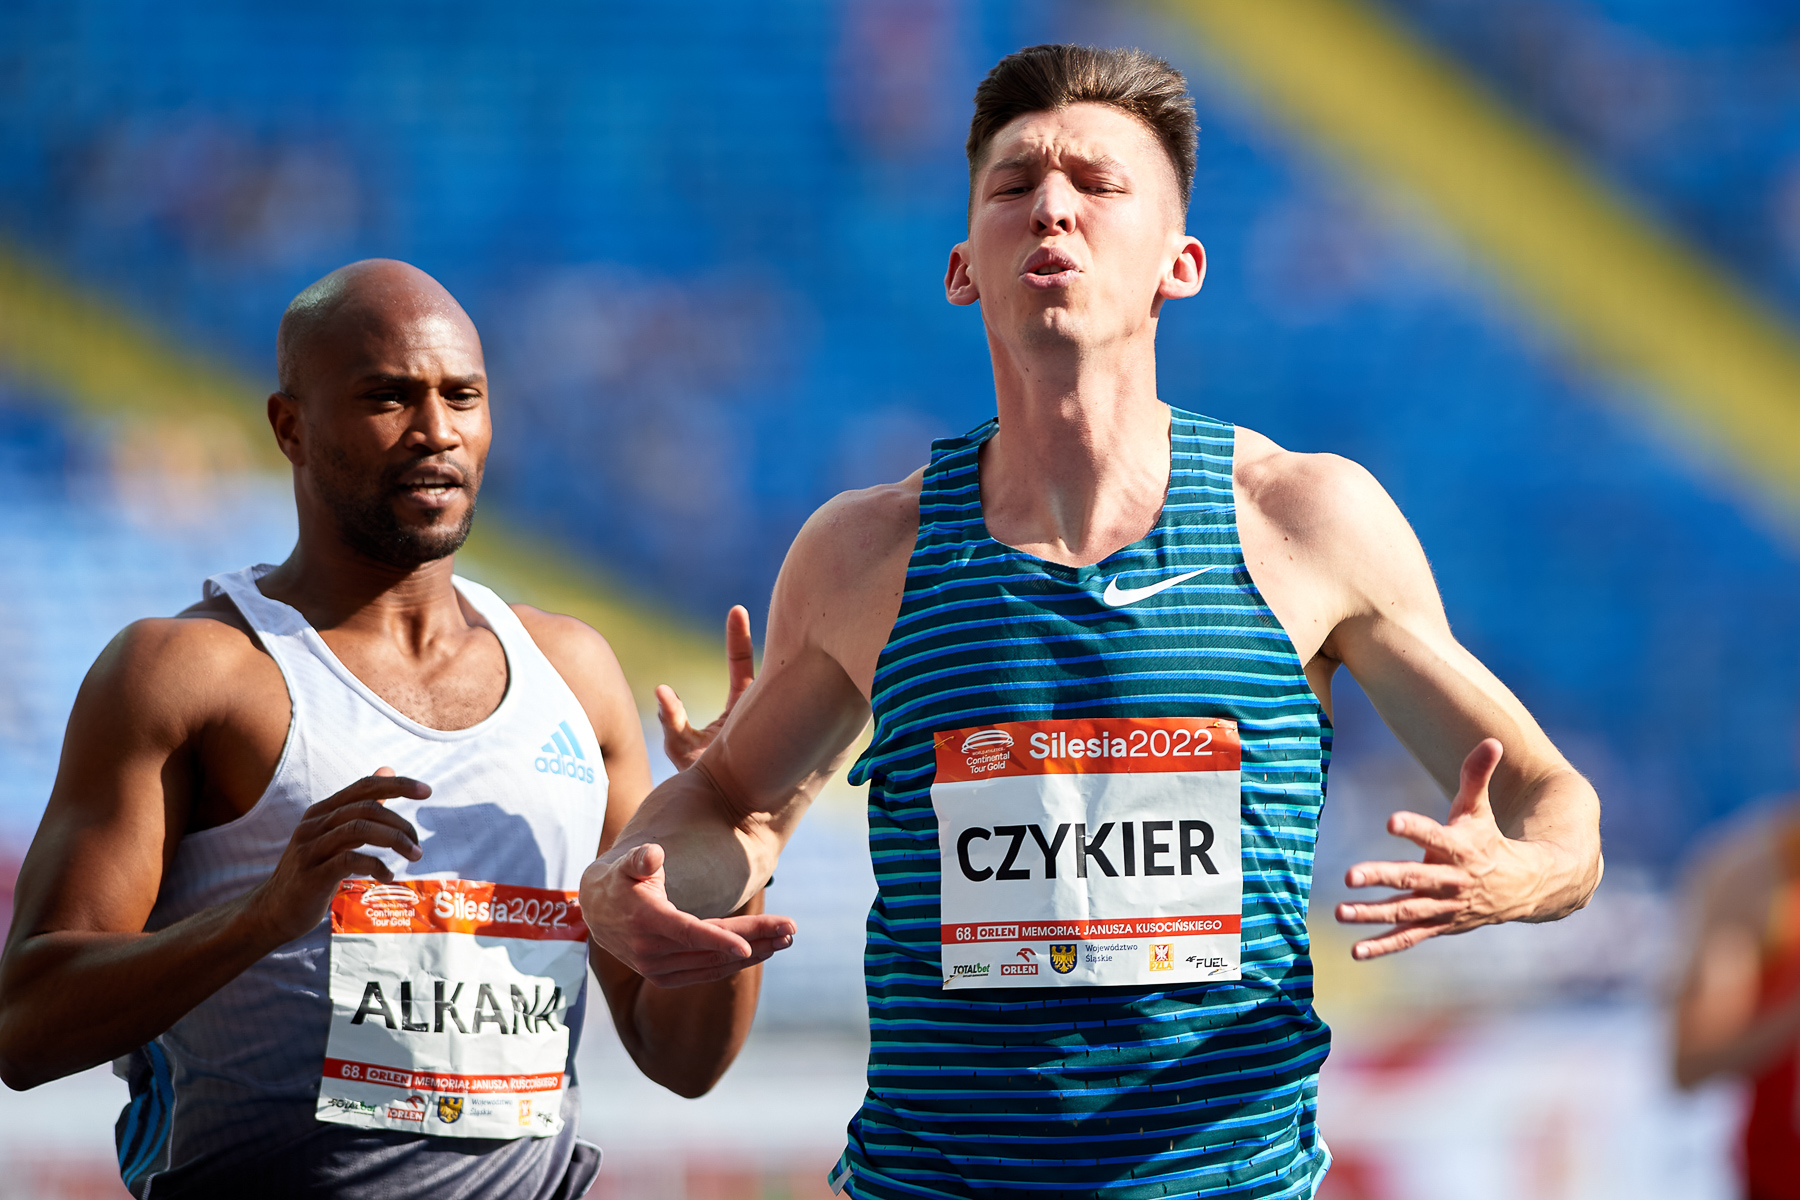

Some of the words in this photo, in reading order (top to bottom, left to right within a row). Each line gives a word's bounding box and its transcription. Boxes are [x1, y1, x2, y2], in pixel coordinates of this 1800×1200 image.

[966, 751, 1010, 766] Continental
[534, 753, 595, 784] adidas
[970, 764, 987, 774] Tour
[987, 761, 1006, 771] Gold
[956, 819, 1220, 883] CZYKIER
[365, 908, 415, 918] Continental
[371, 917, 389, 926] Tour
[390, 917, 411, 926] Gold
[956, 927, 975, 941] 68.
[979, 927, 1017, 938] ORLEN
[1022, 925, 1081, 937] MEMORIAŁ
[1083, 924, 1133, 936] JANUSZA
[1136, 919, 1222, 933] KUSOCIŃSKIEGO
[1085, 944, 1138, 953] Województwo
[1085, 954, 1113, 963] Śląskie
[1196, 957, 1228, 968] FUEL
[1002, 965, 1036, 975] ORLEN
[341, 1064, 364, 1079] 68.
[369, 1070, 410, 1084] ORLEN
[415, 1076, 470, 1089] MEMORIAŁ
[471, 1080, 509, 1089] JANUSZA
[390, 1110, 423, 1121] ORLEN
